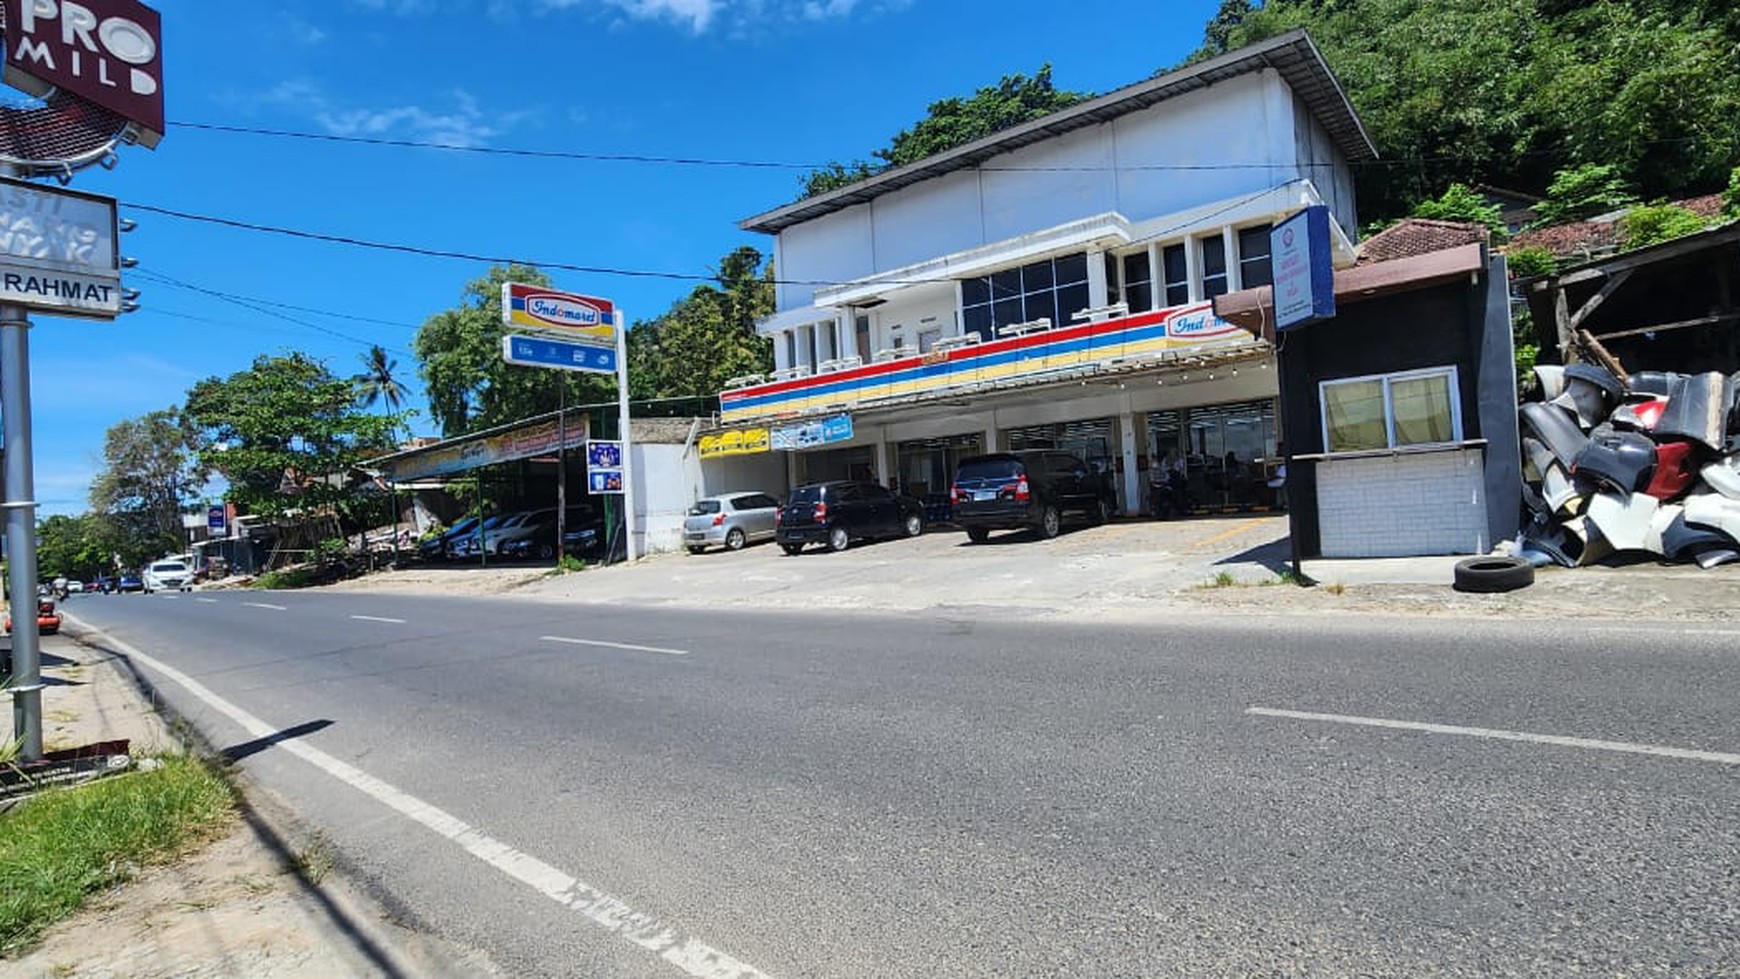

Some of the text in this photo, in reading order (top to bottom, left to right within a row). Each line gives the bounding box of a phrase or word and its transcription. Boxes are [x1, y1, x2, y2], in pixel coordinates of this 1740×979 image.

[20, 0, 156, 65] PRO
[14, 35, 157, 96] MILD
[4, 272, 114, 303] RAHMAT
[532, 300, 596, 322] Indomaret
